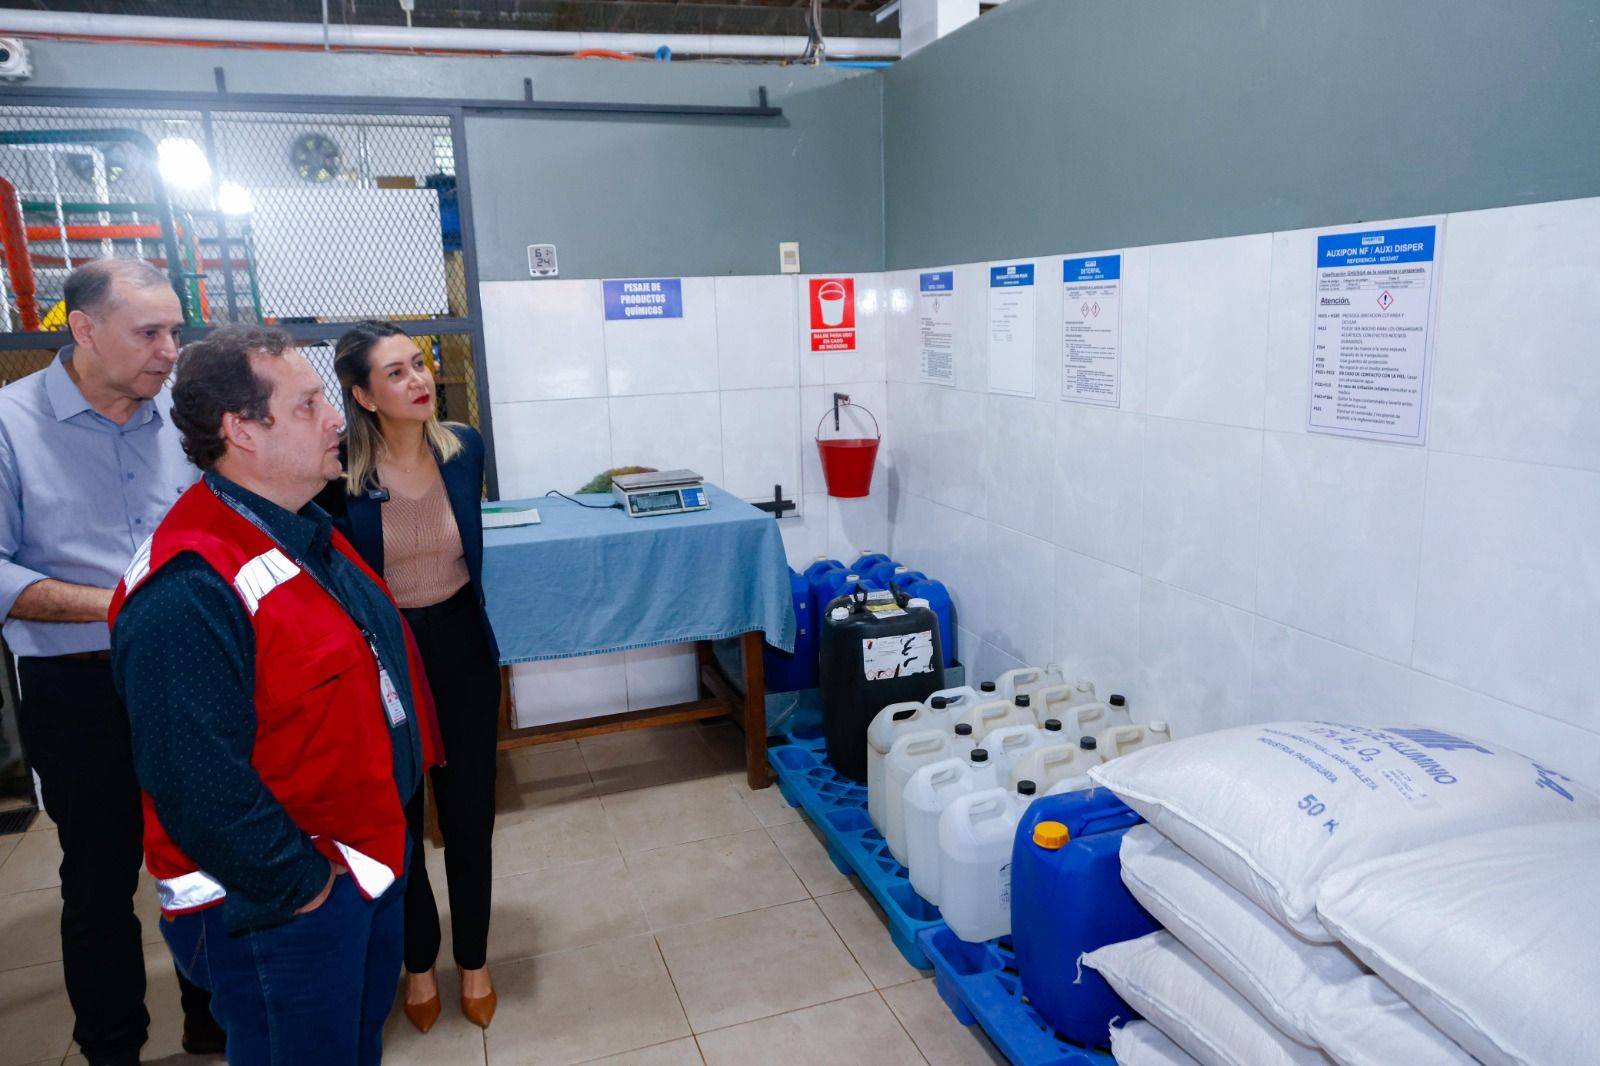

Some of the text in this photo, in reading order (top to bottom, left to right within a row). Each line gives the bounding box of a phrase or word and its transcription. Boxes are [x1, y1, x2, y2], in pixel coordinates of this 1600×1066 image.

[1326, 247, 1358, 258] AUXIPON
[1359, 246, 1370, 255] NF
[1375, 245, 1393, 254] AUXI
[1394, 242, 1424, 252] DISPER
[624, 282, 661, 292] PESAJE DE
[621, 294, 666, 304] PRODUCTOS
[625, 305, 663, 317] QUÍMICOS
[1291, 751, 1338, 784] PARAGUAYA
[1388, 741, 1458, 785] ALUMINIO
[1297, 793, 1326, 817] 50
